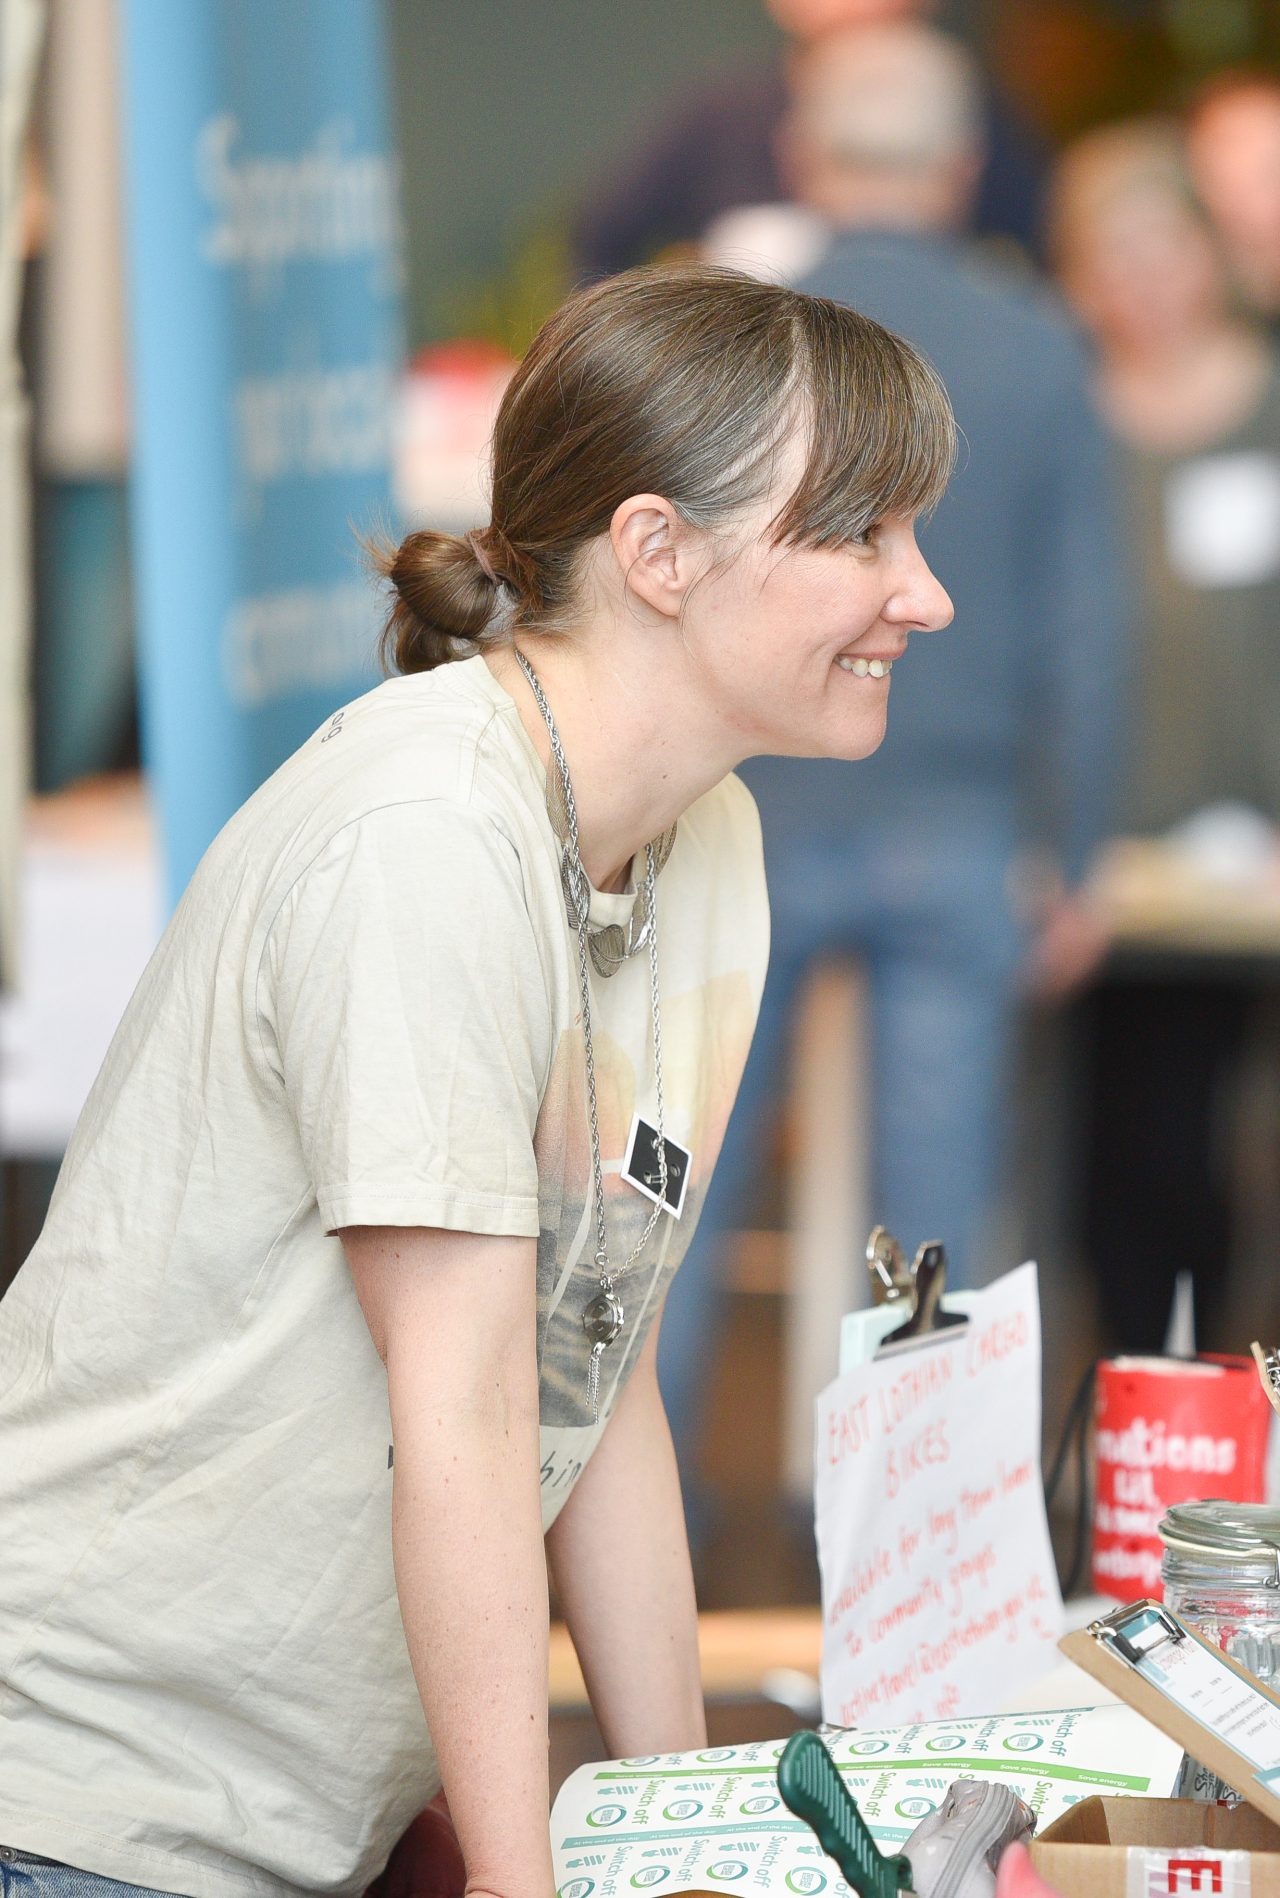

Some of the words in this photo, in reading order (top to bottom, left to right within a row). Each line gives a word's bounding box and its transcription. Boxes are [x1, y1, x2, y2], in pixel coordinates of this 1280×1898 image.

[829, 1395, 870, 1466] EAST
[879, 1354, 953, 1435] LOTHIAN
[887, 1418, 951, 1499] BIKES
[870, 1575, 944, 1644] community
[1053, 1713, 1081, 1739] Switch
[1048, 1739, 1068, 1757] off
[1000, 1763, 1020, 1772] Save
[1021, 1766, 1051, 1776] energy
[1077, 1773, 1098, 1783] Save
[1098, 1777, 1129, 1788] energy
[638, 1779, 666, 1807] Switch
[715, 1776, 743, 1805] Switch
[871, 1771, 897, 1802] Switch
[631, 1808, 650, 1825] off
[708, 1805, 726, 1819] off
[863, 1801, 882, 1818] off
[605, 1845, 633, 1878] Switch
[681, 1839, 710, 1869] Switch
[759, 1834, 788, 1868] Switch
[599, 1878, 617, 1897] off
[674, 1868, 693, 1883] off
[752, 1867, 772, 1889] off
